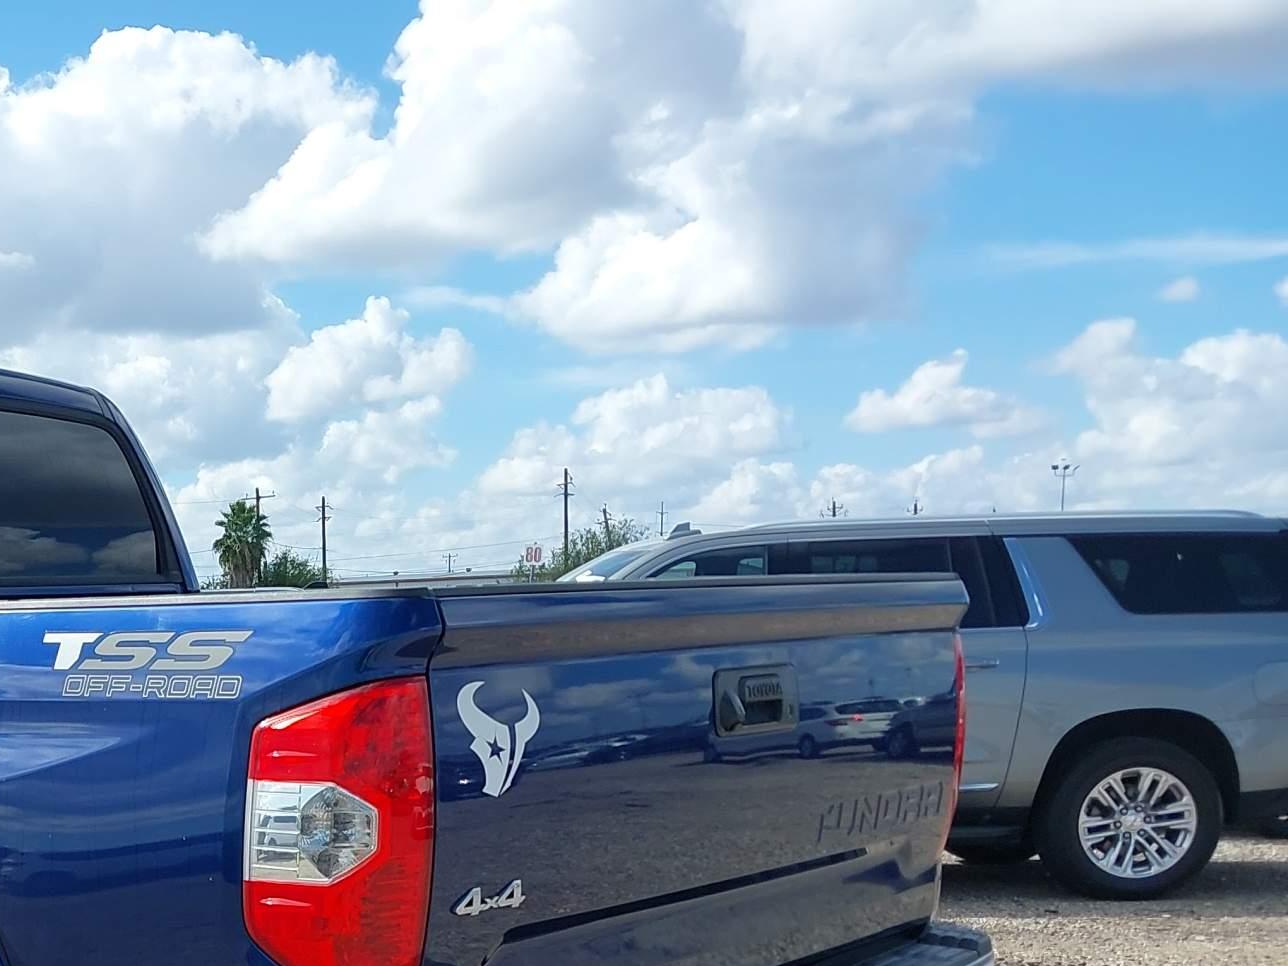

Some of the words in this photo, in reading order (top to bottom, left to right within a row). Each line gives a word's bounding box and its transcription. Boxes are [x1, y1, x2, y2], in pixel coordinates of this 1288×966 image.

[525, 546, 543, 564] 80
[42, 630, 255, 671] TSS
[62, 674, 242, 698] OFF-ROAD
[816, 780, 944, 845] TUNDRA
[452, 879, 526, 917] 4x4
